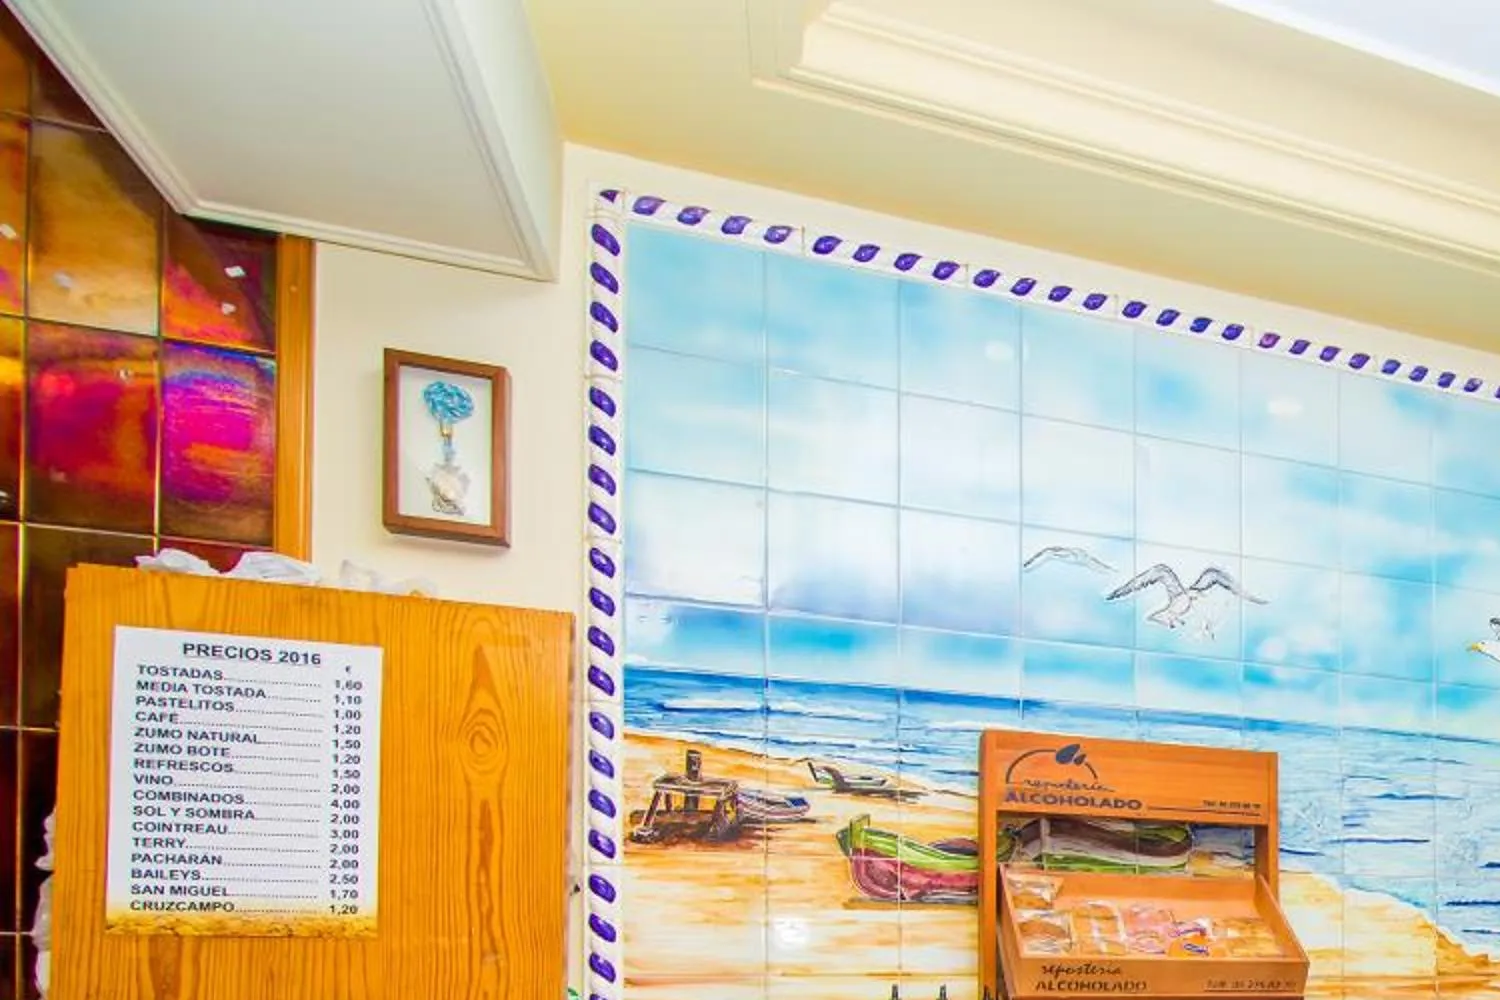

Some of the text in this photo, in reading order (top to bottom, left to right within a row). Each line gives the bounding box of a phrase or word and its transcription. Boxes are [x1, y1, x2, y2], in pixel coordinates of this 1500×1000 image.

[183, 643, 321, 666] PRECIOS 2016
[137, 664, 223, 680] TOSTADAS
[136, 680, 188, 693] MEDIA
[193, 683, 267, 698] TOSTADA
[136, 696, 361, 720] PASTELITOS 1,00
[134, 727, 183, 739] ZUMO
[187, 730, 258, 744] NATURAL
[134, 742, 183, 755] ZUMO
[187, 745, 231, 757] BOTE
[134, 758, 234, 773] REFRESCOS
[133, 774, 174, 785] VINO
[133, 789, 360, 810] COMBINADOS 4,00
[1006, 791, 1143, 811] ALCOHOLADO
[133, 805, 360, 825] SOL Y SOMBRA 2,00
[132, 821, 359, 840] COINTREAU 3,00
[132, 837, 187, 848] TERRY
[131, 868, 202, 880] BAILEYS
[130, 883, 359, 900] SAN MIGUEL 1,70
[130, 899, 358, 915] CRUZCAMPO 1,20
[1035, 980, 1148, 992] ALCOHOLADO
